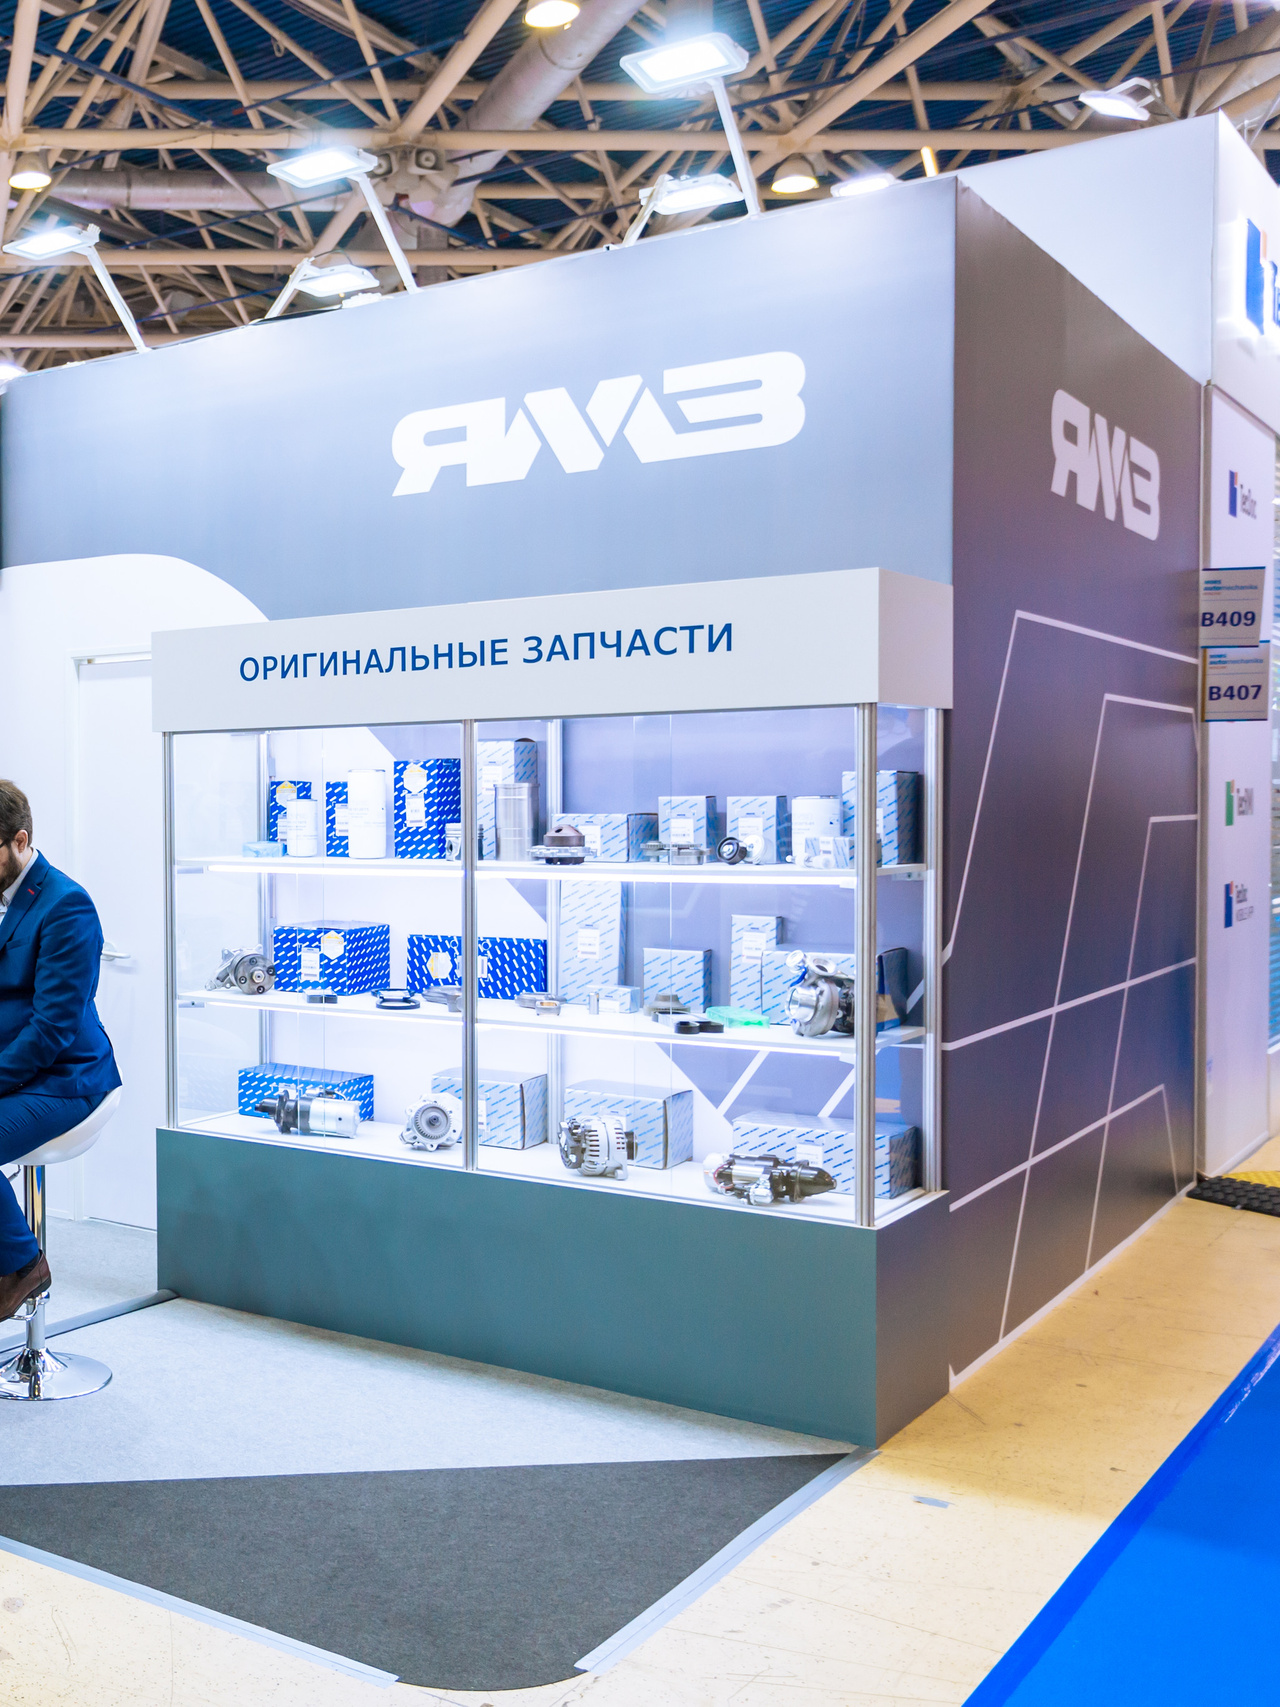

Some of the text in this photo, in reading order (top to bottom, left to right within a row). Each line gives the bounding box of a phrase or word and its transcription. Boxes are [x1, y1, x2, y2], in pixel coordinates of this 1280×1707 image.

[391, 351, 807, 497] ЯМЗ
[1201, 610, 1256, 627] B409
[239, 623, 734, 682] ОРИГИНАЛЬНЫЕ ЗАПЧАСТИ
[1208, 684, 1262, 701] B407
